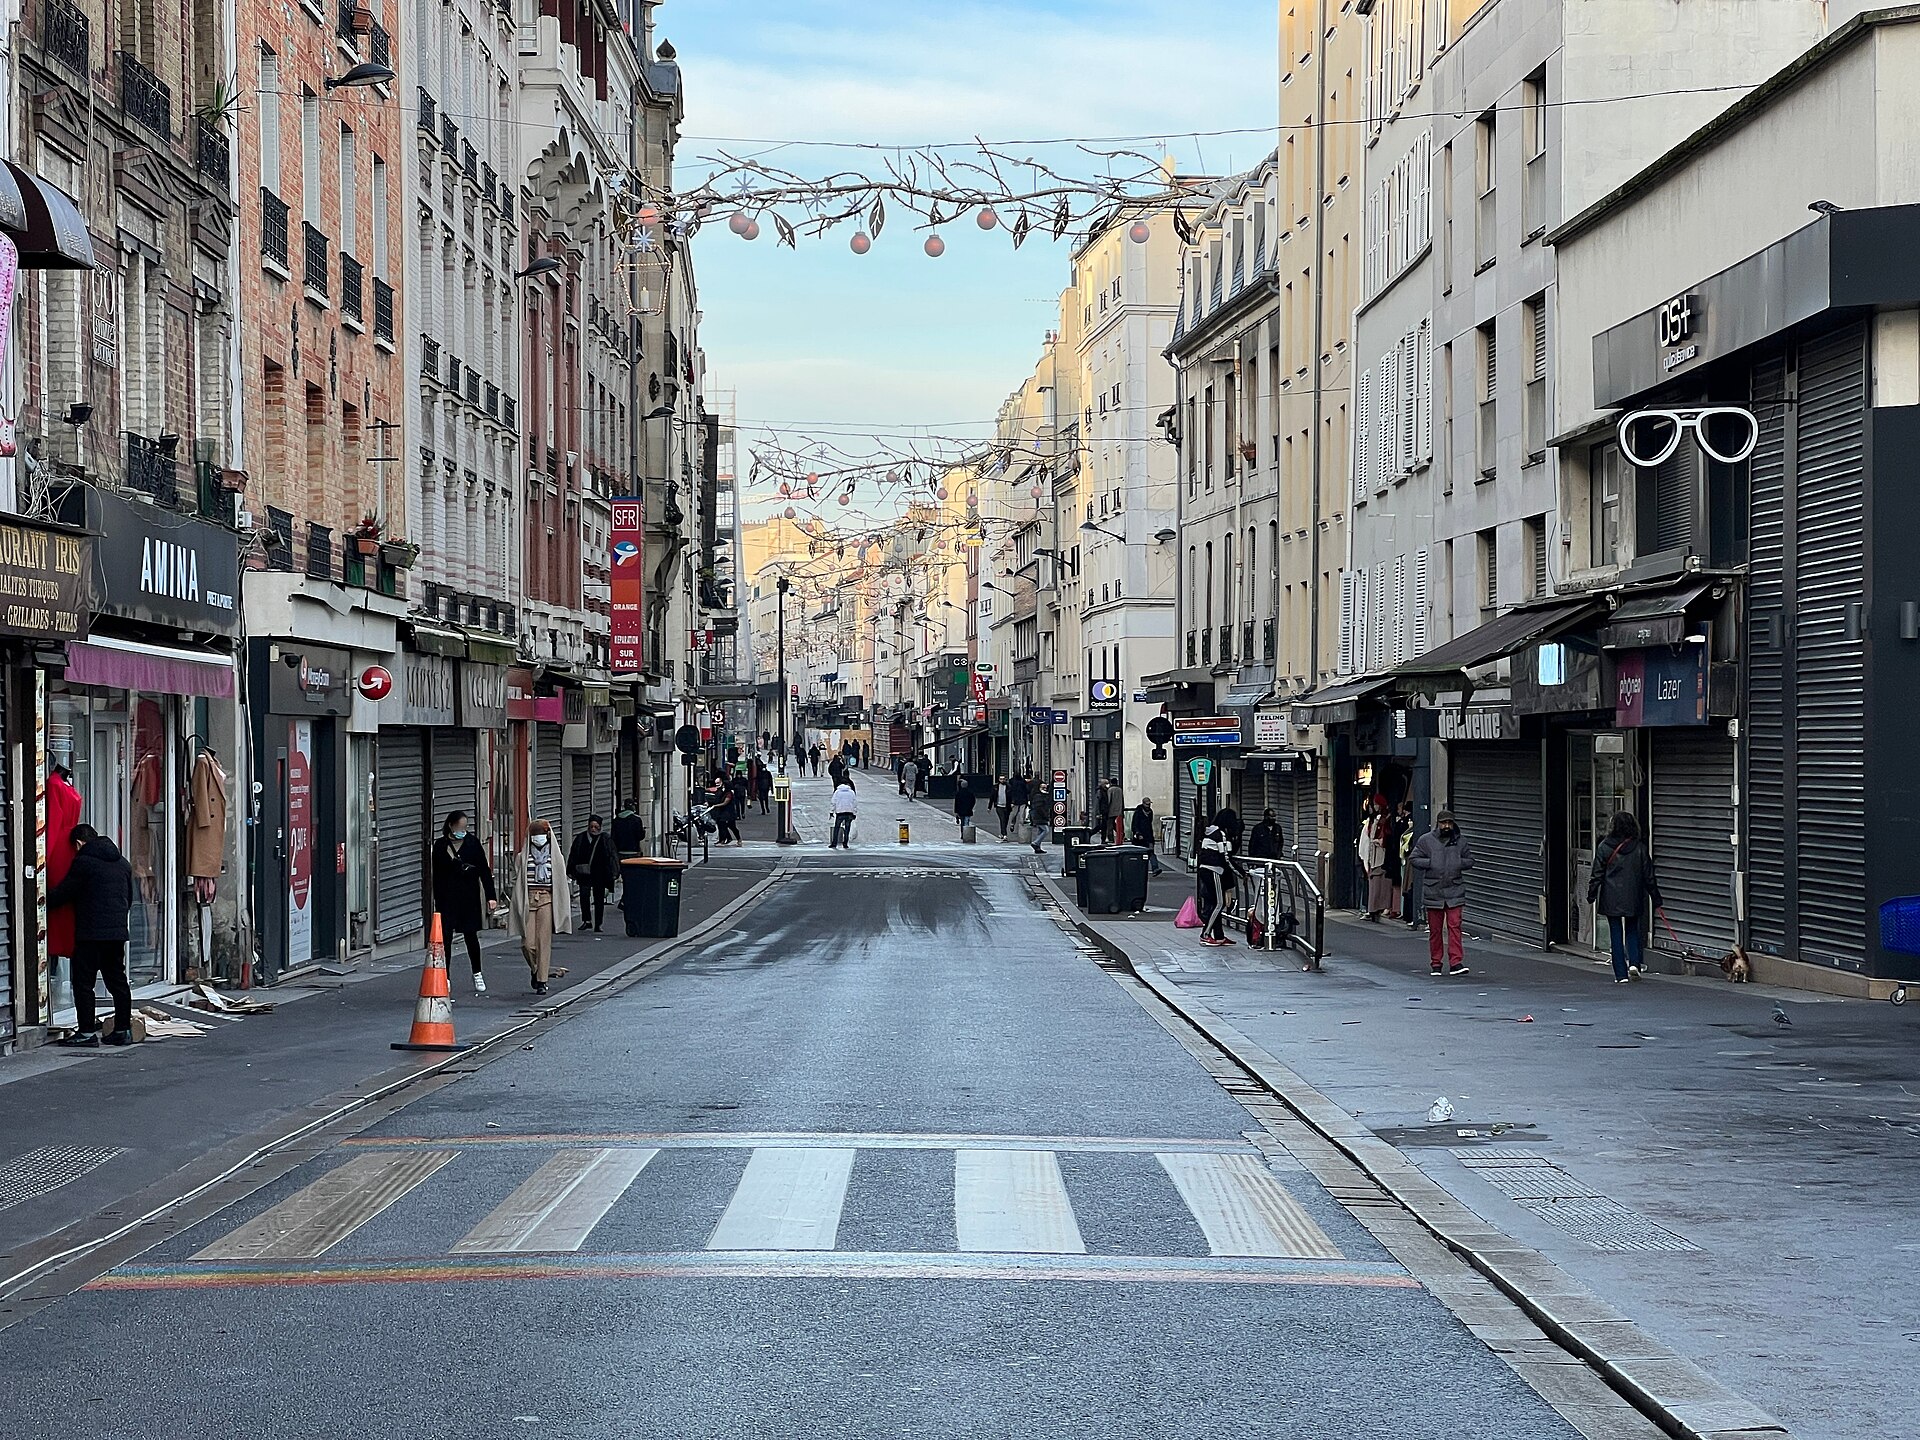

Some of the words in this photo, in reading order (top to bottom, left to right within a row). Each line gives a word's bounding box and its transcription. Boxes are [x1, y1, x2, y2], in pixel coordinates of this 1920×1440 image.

[615, 509, 636, 526] SFR
[55, 535, 80, 575] IRIS
[140, 536, 199, 602] AMINA
[28, 578, 59, 604] TURQUES
[7, 604, 50, 630] GRILLADES
[55, 611, 78, 633] PIZZAS
[615, 660, 638, 668] PLACE
[619, 649, 634, 657] SUR
[1657, 673, 1682, 700] Lazer
[1438, 708, 1501, 739] delaveine
